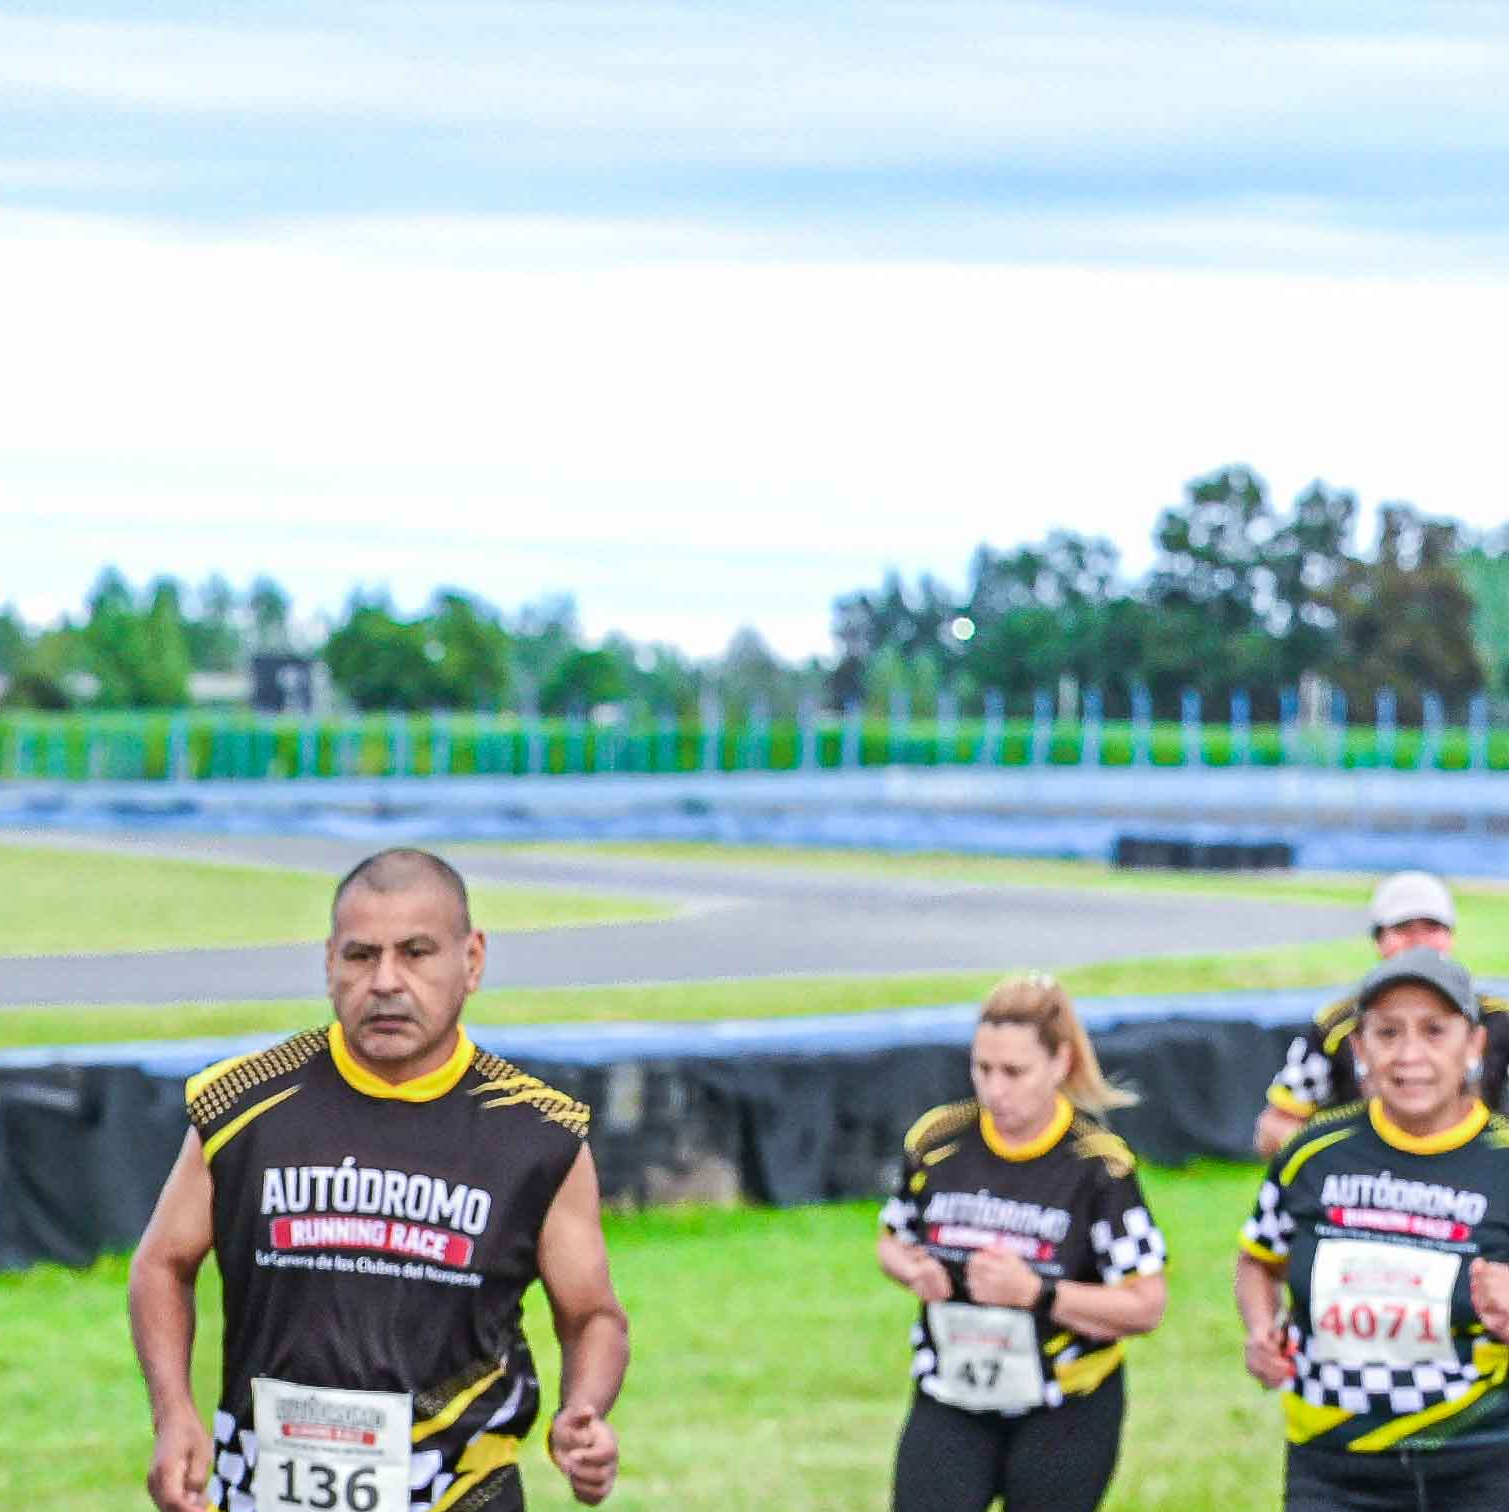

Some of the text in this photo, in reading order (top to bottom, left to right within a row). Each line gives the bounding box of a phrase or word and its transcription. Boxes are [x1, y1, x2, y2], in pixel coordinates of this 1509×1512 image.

[260, 1156, 492, 1235] AUTÓDROMO
[290, 1218, 450, 1261] RUNNING RACE
[1319, 1302, 1440, 1343] 4071
[278, 1459, 379, 1512] 136
